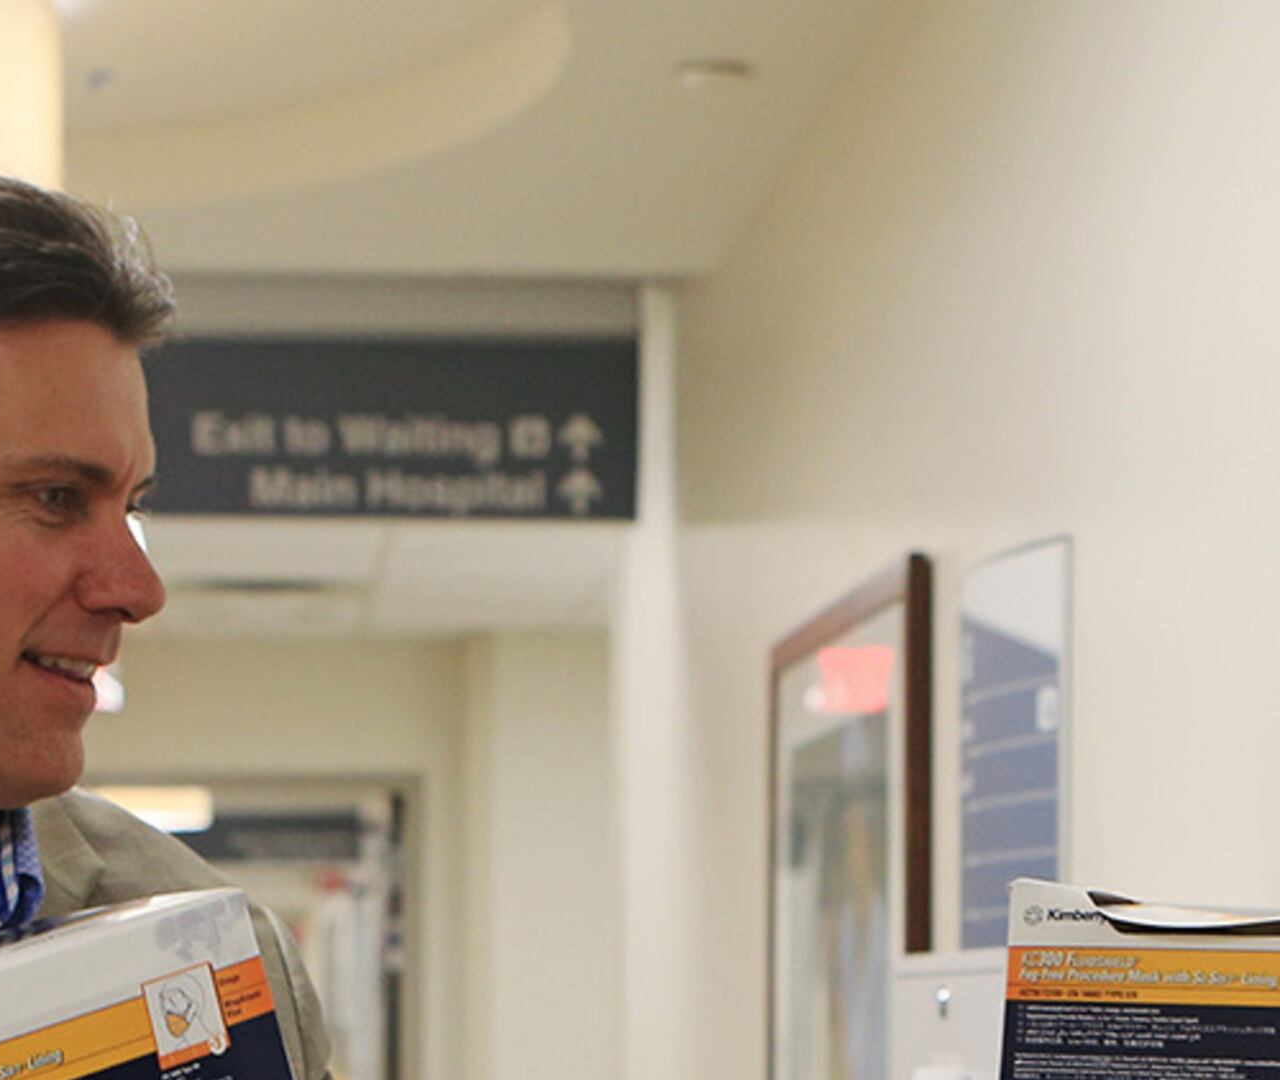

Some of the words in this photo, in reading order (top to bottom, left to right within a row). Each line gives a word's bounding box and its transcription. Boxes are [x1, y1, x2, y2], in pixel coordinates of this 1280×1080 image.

[192, 411, 275, 455] Exit
[284, 417, 331, 455] to
[338, 413, 501, 464] Waiting
[249, 467, 358, 508] Main
[365, 470, 546, 516] Hospital
[1021, 951, 1065, 967] KC300
[1128, 970, 1161, 984] Mask
[1166, 971, 1192, 985] with
